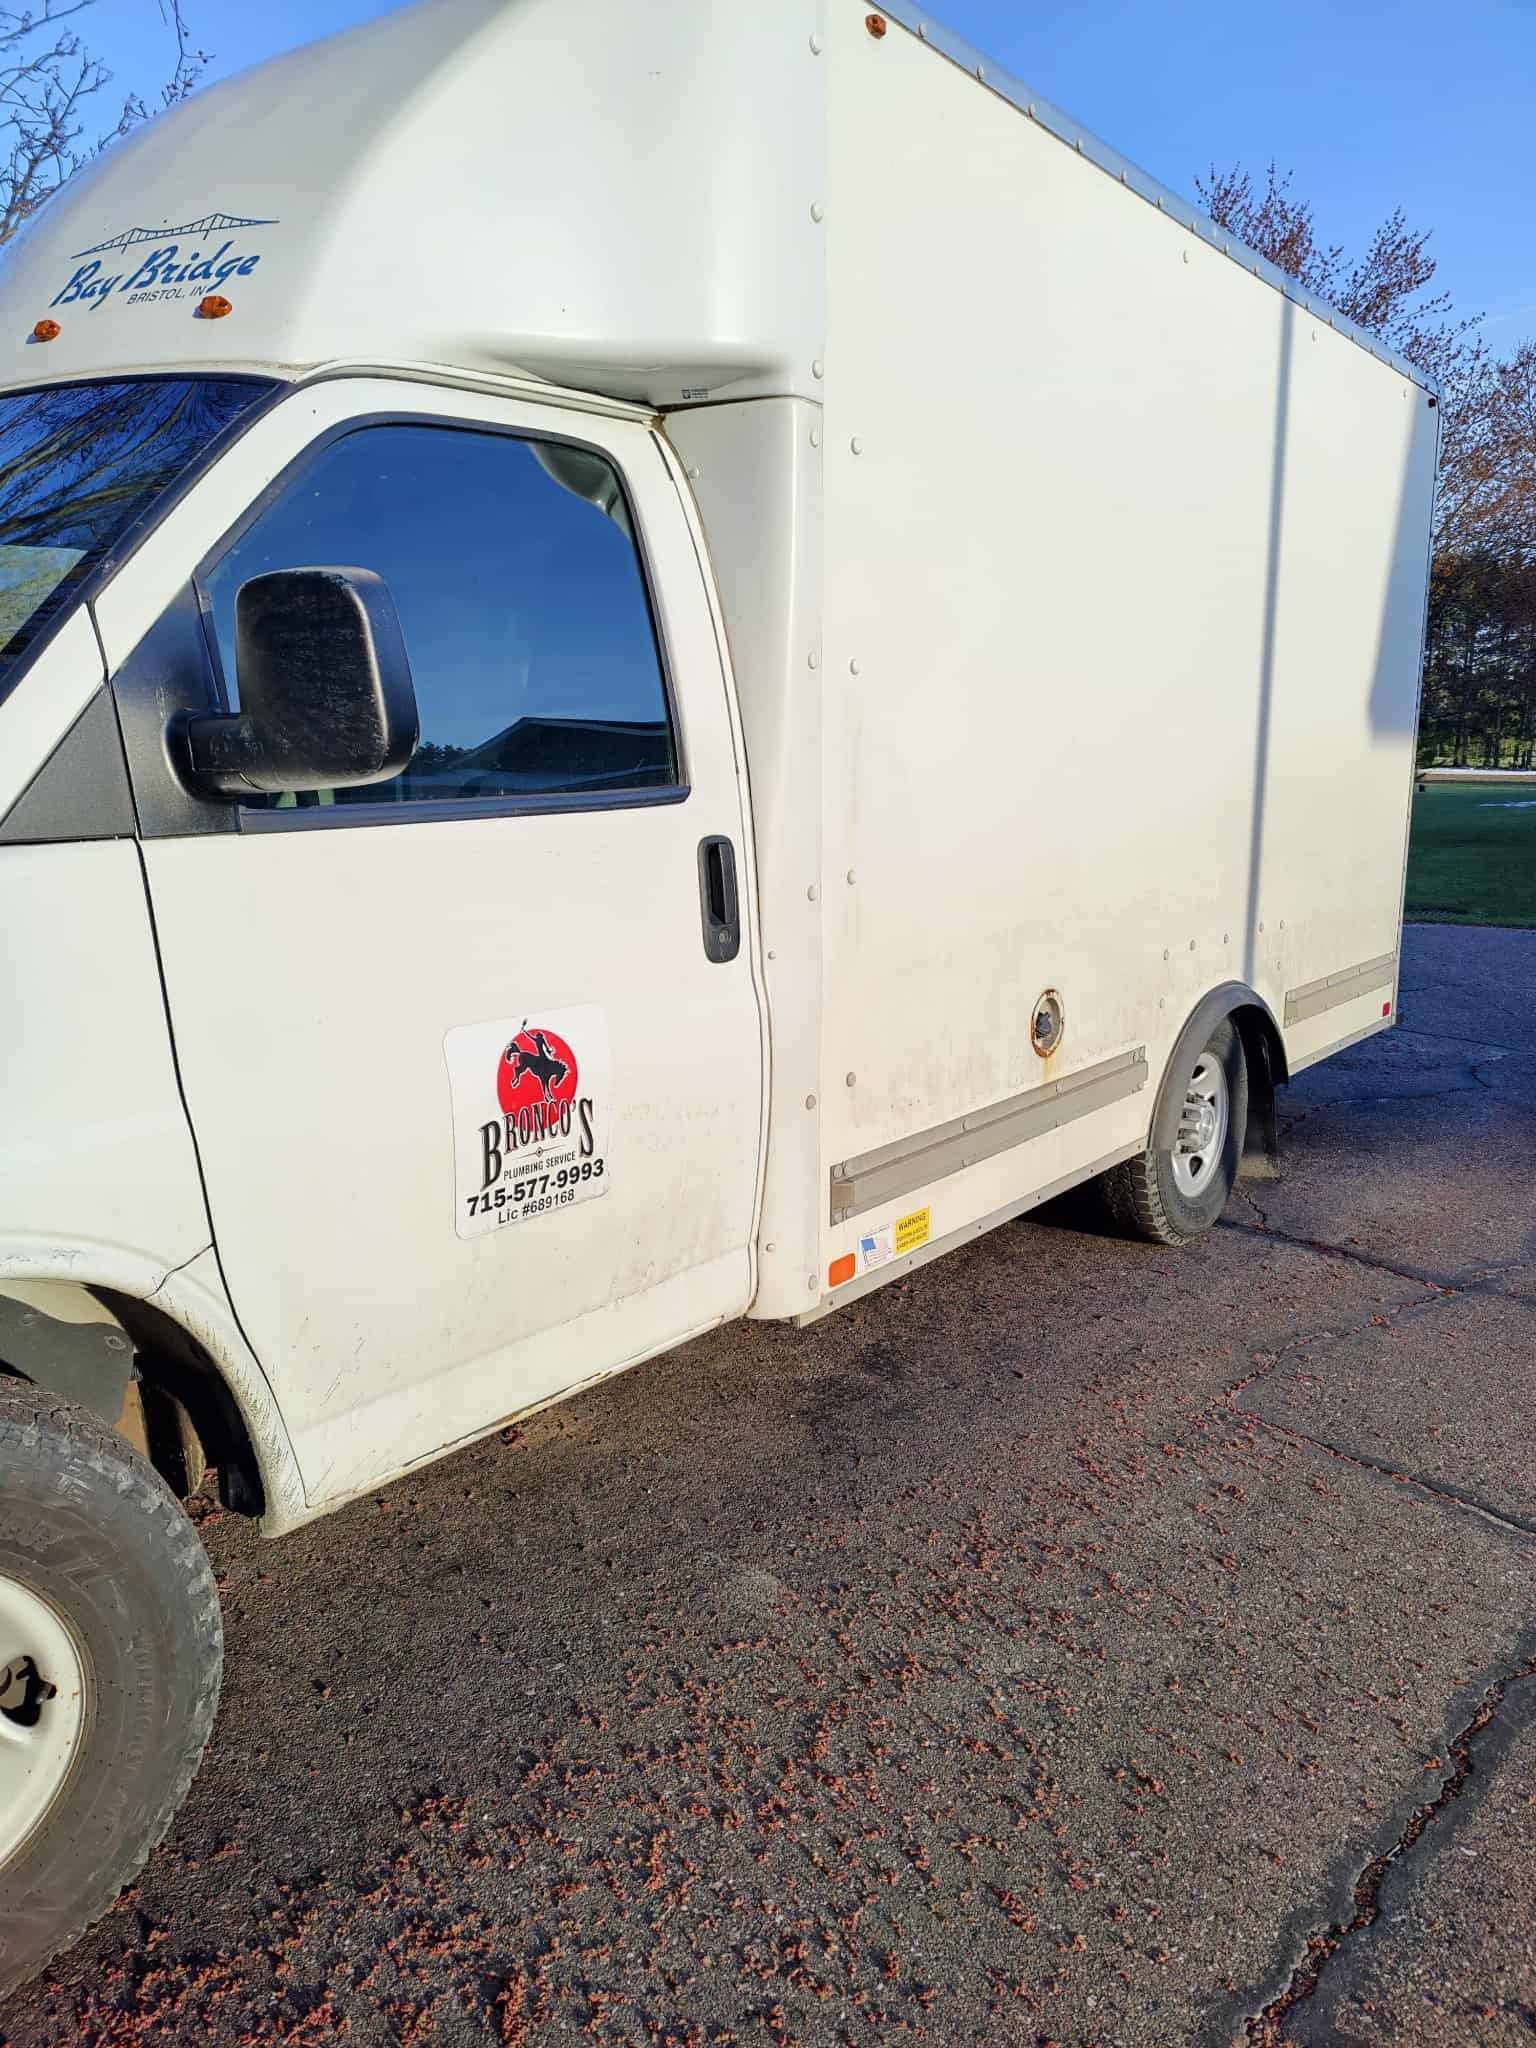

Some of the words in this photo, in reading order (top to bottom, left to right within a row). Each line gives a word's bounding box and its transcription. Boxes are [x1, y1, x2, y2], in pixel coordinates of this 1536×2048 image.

[48, 260, 123, 310] Bay
[118, 240, 260, 293] Bridge
[127, 288, 185, 304] BRISTOL,
[191, 286, 206, 298] IN
[479, 1097, 594, 1190] BRONCO'S
[503, 1160, 543, 1181] PLUMBING
[546, 1151, 576, 1169] SERVICE
[467, 1158, 604, 1217] 715-577-9993
[498, 1208, 518, 1224] Lic
[522, 1189, 575, 1216] #689168
